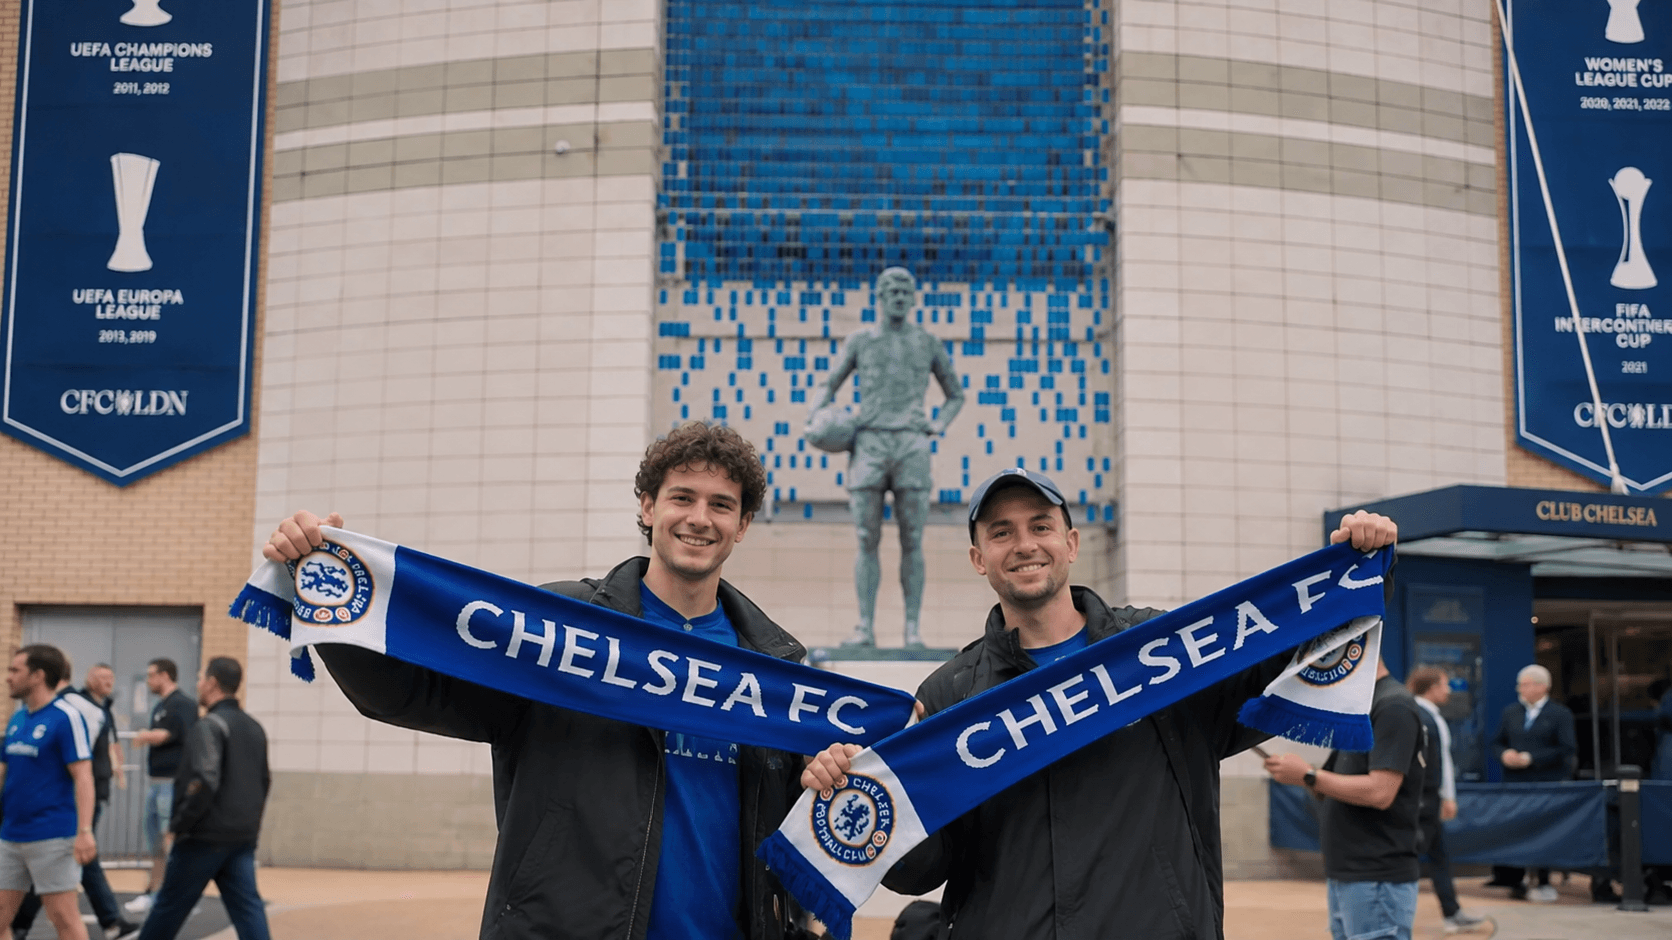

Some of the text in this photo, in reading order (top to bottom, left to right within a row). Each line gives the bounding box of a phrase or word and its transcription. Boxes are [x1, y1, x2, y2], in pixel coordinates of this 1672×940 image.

[70, 42, 213, 58] UEFA CHAMPIONS
[110, 57, 174, 72] LEAGUE
[1584, 56, 1664, 73] WOMEN'S
[1575, 71, 1672, 88] LEAGUE CUP
[113, 82, 170, 95] 2011, 2012
[1580, 96, 1671, 112] 2020, 2021, 2022
[73, 288, 184, 305] UEFA EUROPA
[95, 304, 161, 320] LEAGUE
[1615, 303, 1651, 318] FIFA
[98, 329, 157, 344] 2013, 2019
[1615, 333, 1652, 348] CUP
[1622, 360, 1648, 374] 2021
[60, 389, 189, 416] CFC LDN
[1535, 500, 1658, 527] CLUB CHELSEA
[456, 600, 869, 735] CHELSEA FC
[955, 550, 1384, 769] CHELSEA FC
